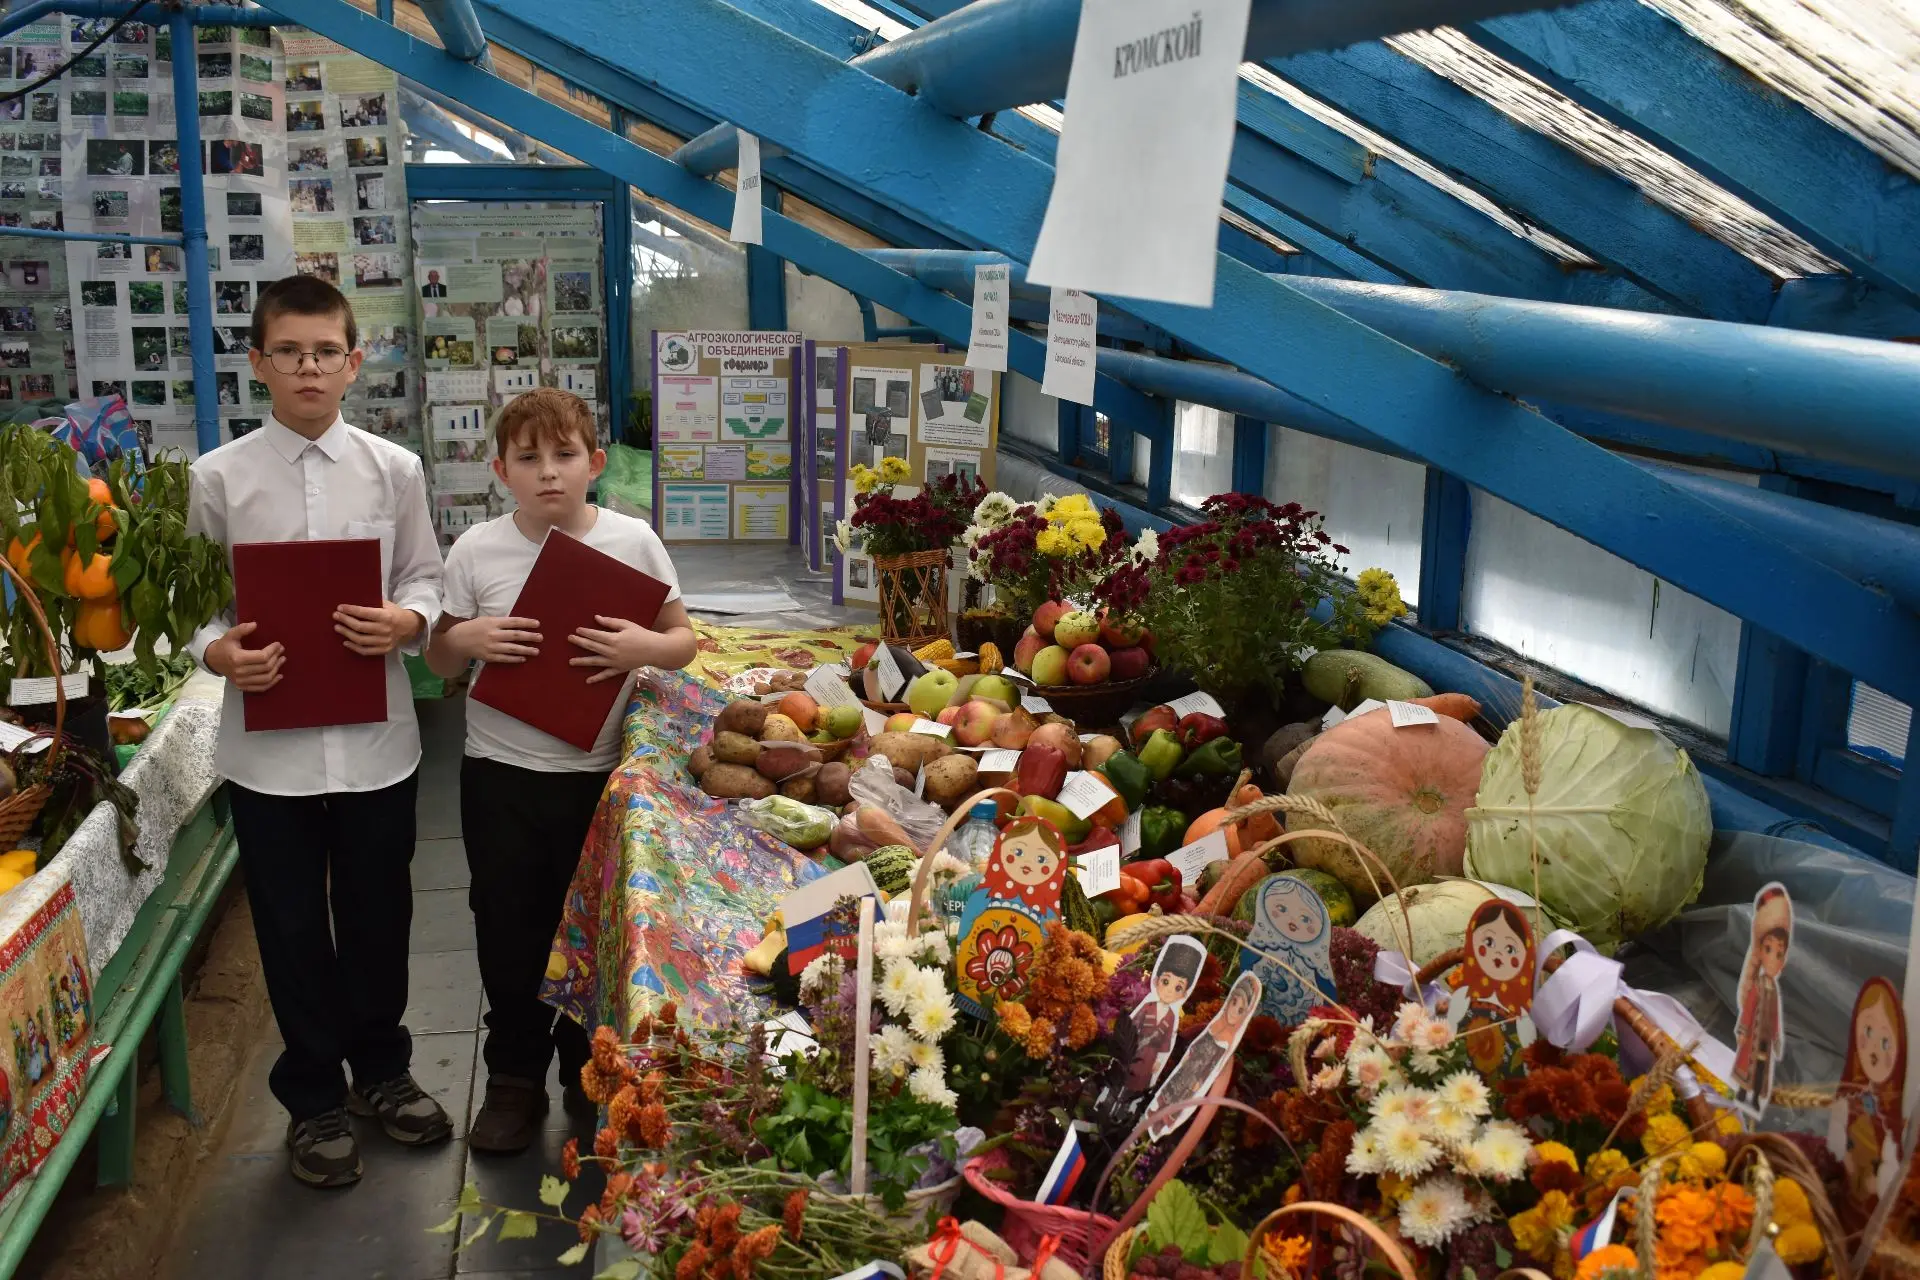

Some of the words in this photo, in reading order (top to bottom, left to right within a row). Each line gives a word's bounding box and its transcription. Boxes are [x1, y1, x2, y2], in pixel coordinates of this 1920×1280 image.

[1114, 10, 1202, 78] КРОМСКОЙ
[687, 332, 802, 345] АГРОЭКОЛОГИЧЕСКОЕ
[707, 345, 785, 357] ОБЪЕДИНЕНИЕ
[723, 358, 769, 373] «Фермер»
